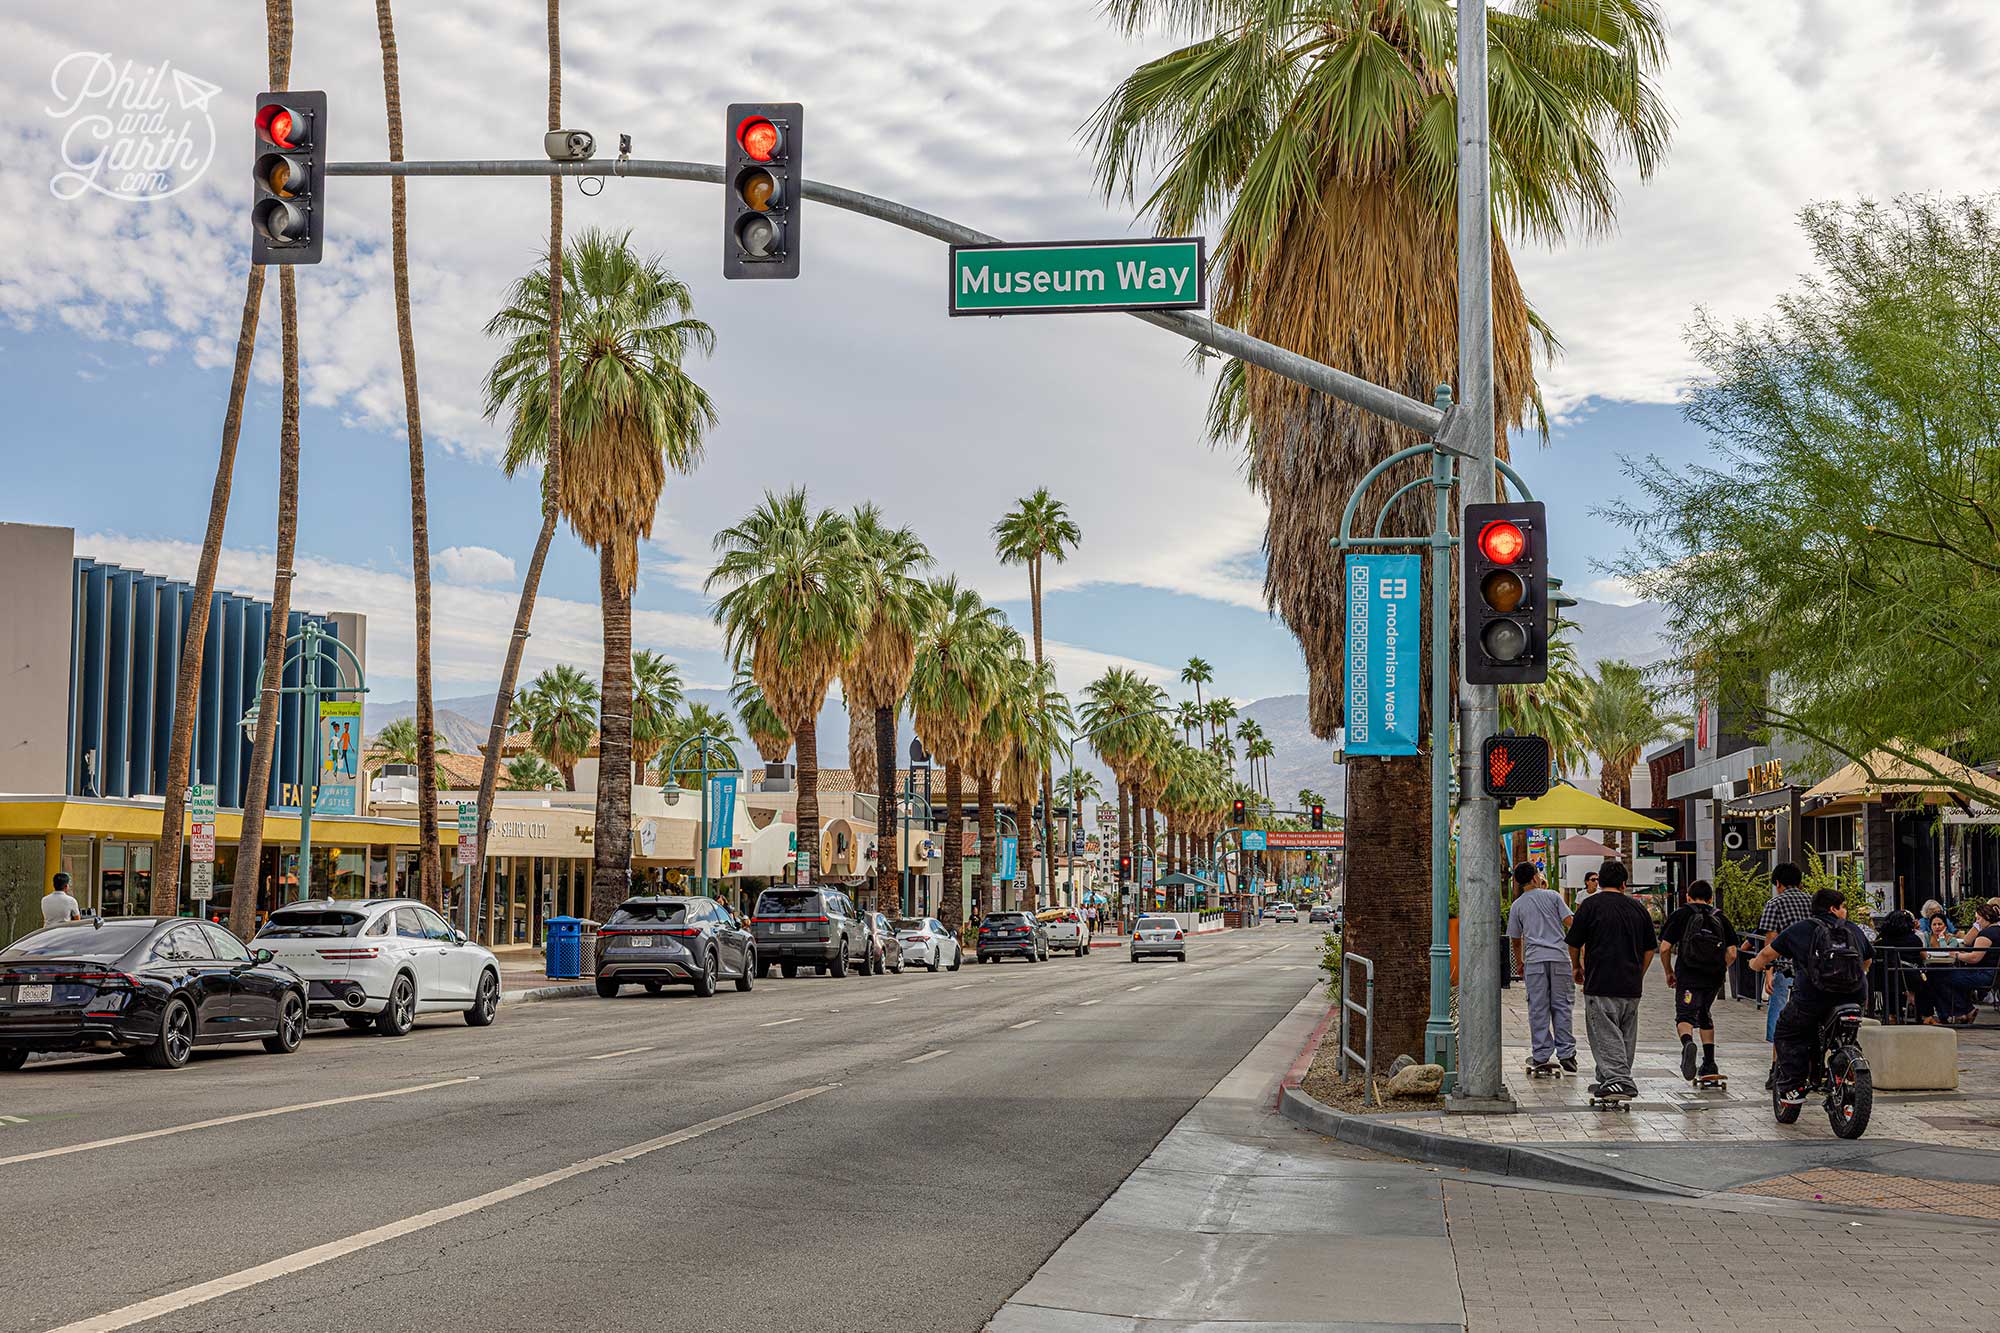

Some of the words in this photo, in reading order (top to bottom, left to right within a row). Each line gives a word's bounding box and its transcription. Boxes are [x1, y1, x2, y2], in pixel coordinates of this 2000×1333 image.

[962, 265, 1105, 294] Museum
[1116, 260, 1190, 296] Way
[1385, 603, 1399, 688] modernism
[1385, 691, 1398, 731] week
[194, 787, 200, 795] 3
[283, 783, 318, 807] FAE
[193, 825, 201, 834] NO
[528, 822, 548, 840] CITY
[1013, 880, 1026, 888] 25
